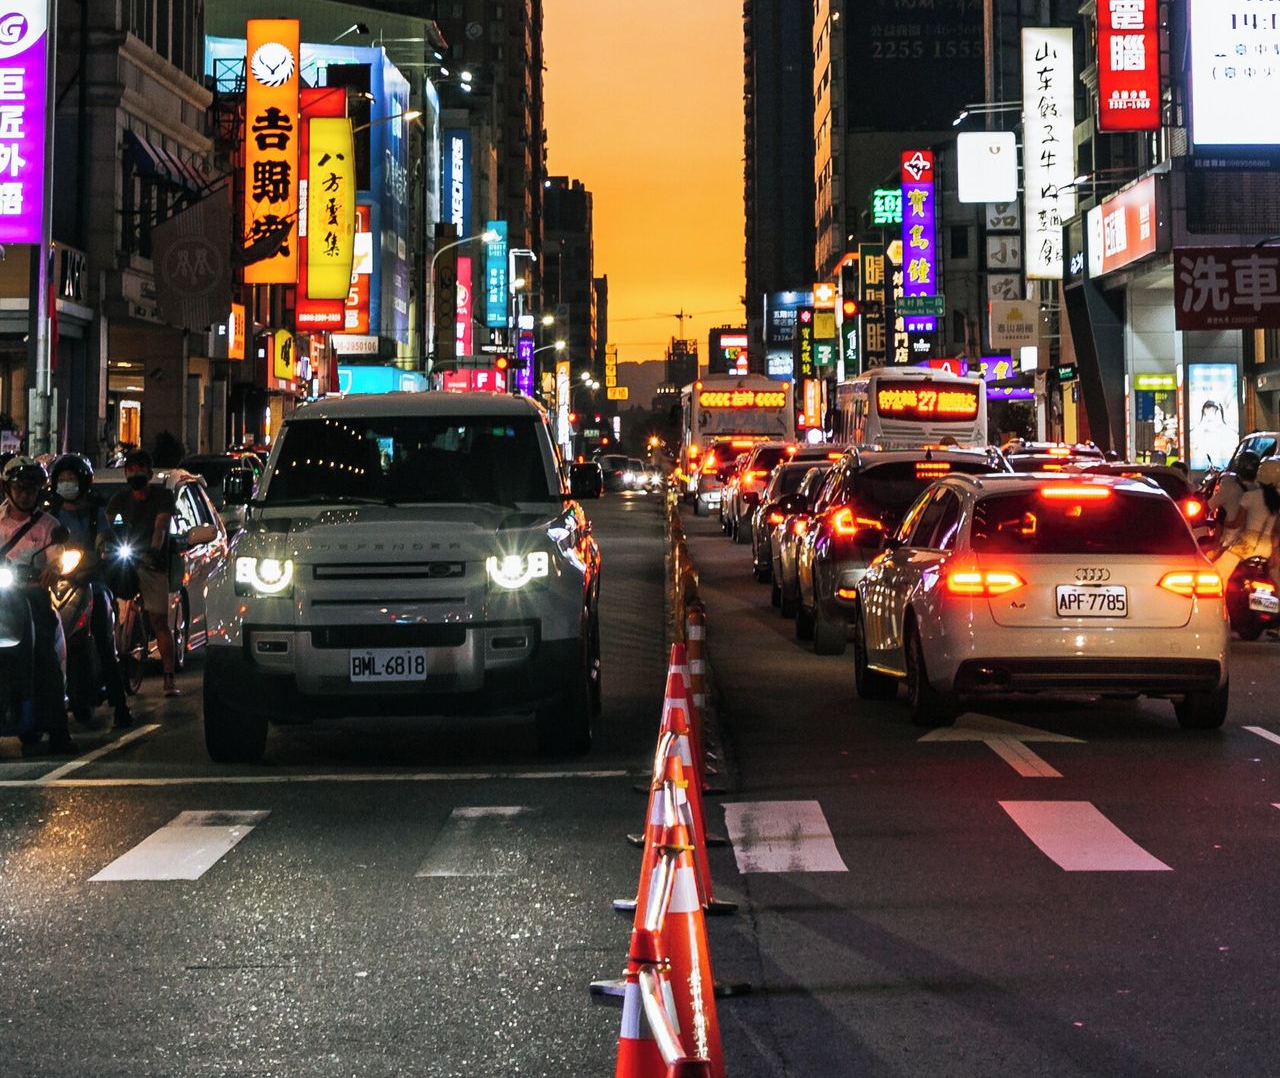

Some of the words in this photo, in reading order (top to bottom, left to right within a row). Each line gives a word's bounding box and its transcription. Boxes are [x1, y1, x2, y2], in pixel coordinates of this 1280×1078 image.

[317, 152, 346, 258] 八方雲集
[907, 188, 931, 298] 寶島鐘
[918, 390, 937, 411] 27
